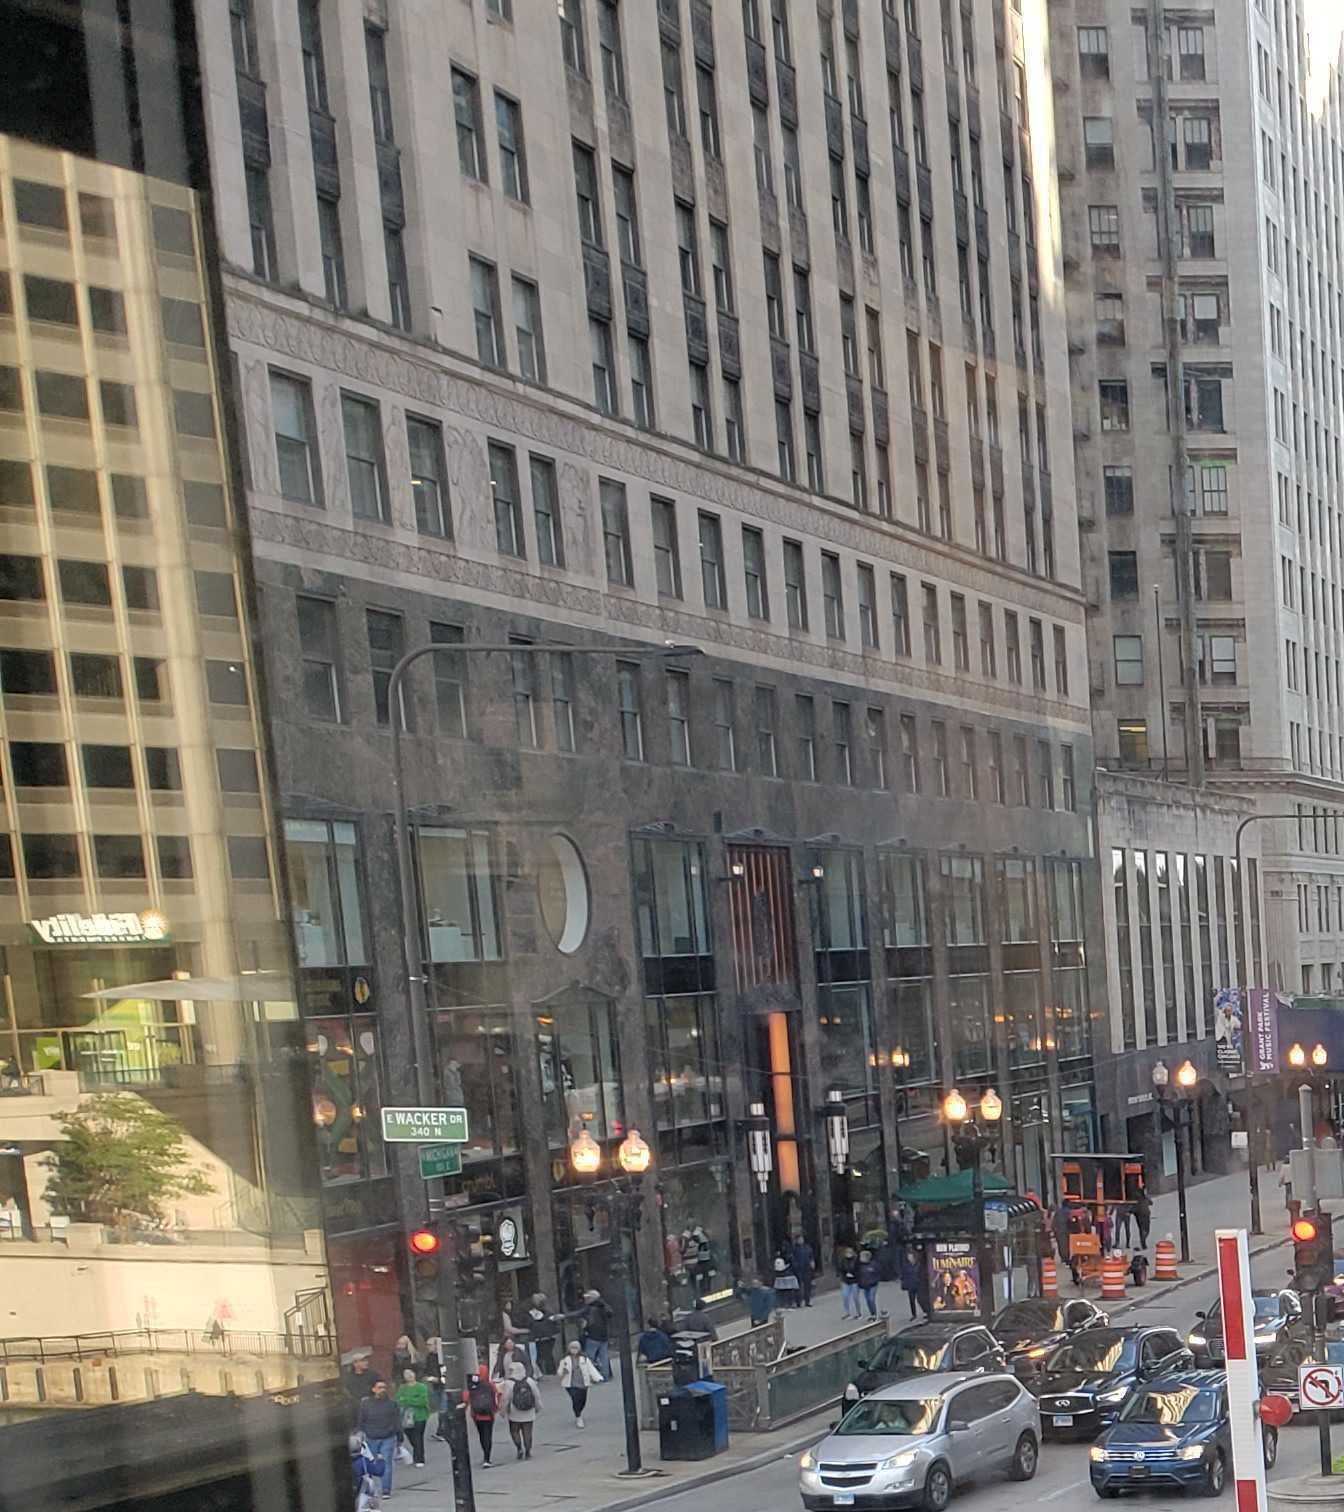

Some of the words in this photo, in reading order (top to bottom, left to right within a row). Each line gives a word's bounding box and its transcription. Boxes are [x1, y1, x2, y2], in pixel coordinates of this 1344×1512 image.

[387, 1115, 394, 1124] E
[395, 1112, 447, 1126] WACKER
[450, 1115, 463, 1124] DR
[410, 1127, 429, 1137] 340
[434, 1127, 442, 1136] N
